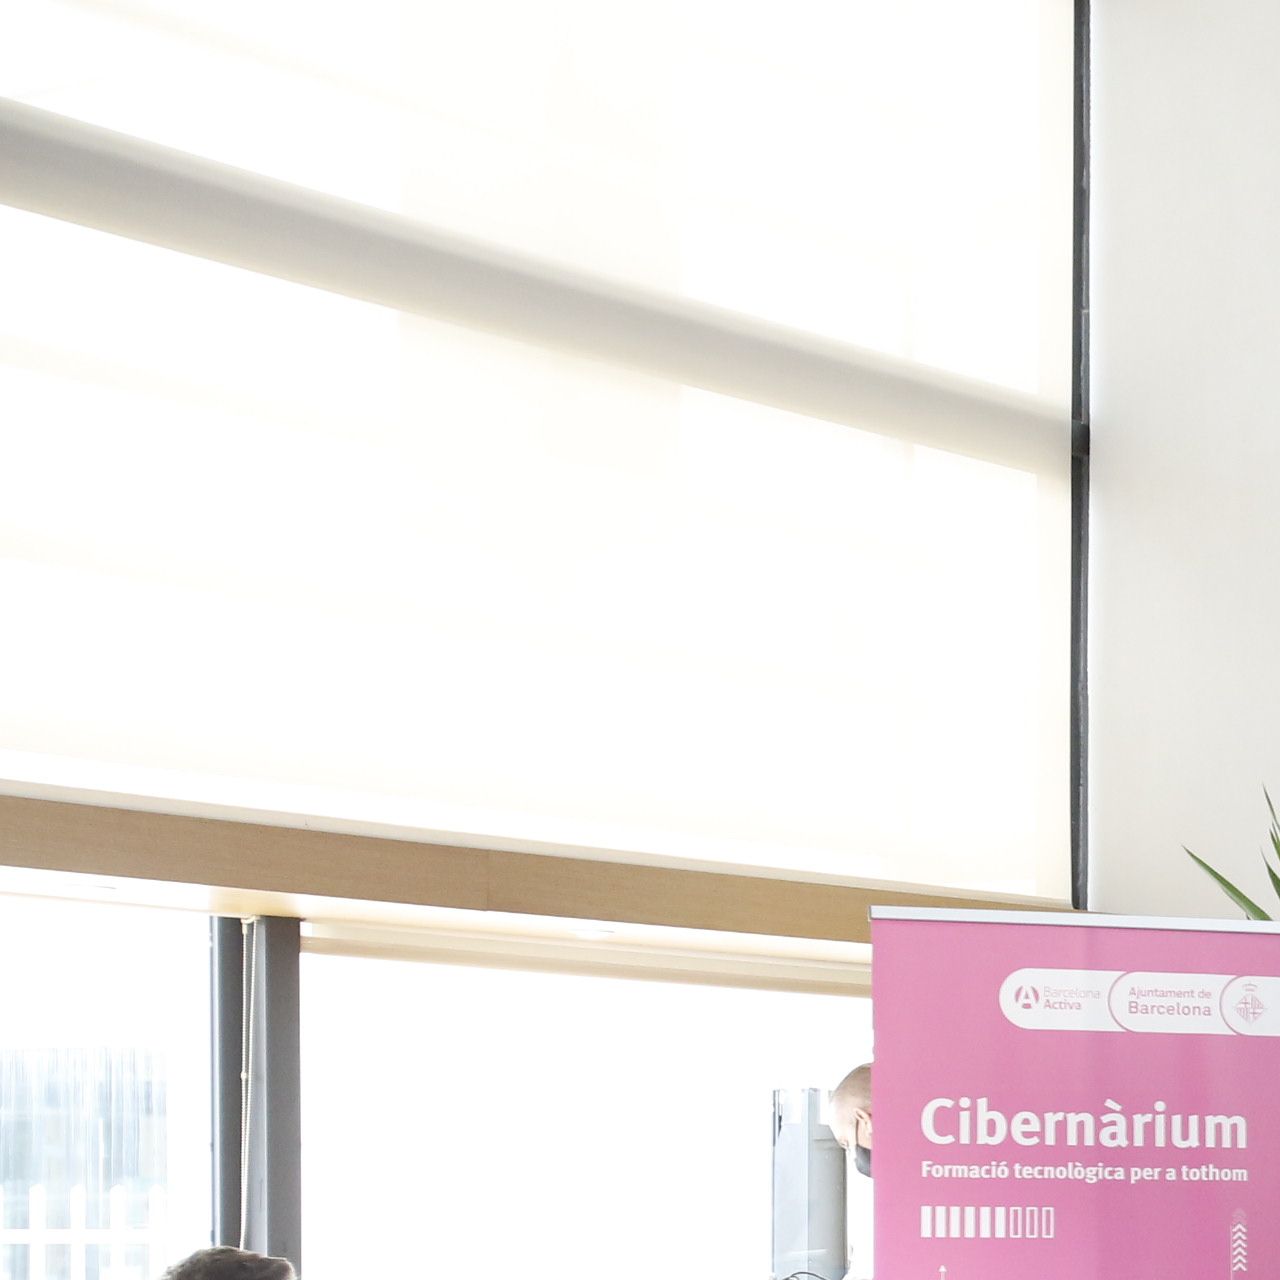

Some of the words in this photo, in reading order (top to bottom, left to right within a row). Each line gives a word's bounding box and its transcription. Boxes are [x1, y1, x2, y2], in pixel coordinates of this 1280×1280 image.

[1128, 986, 1197, 1001] Ajuntament
[1199, 988, 1212, 1000] de
[1128, 1001, 1212, 1017] Barcelona
[920, 1097, 1248, 1149] Cibernàrium
[921, 1160, 1009, 1180] Formació
[1013, 1162, 1125, 1184] tecnològica
[1130, 1167, 1161, 1184] per
[1165, 1168, 1176, 1181] a
[1181, 1164, 1248, 1182] tothom
